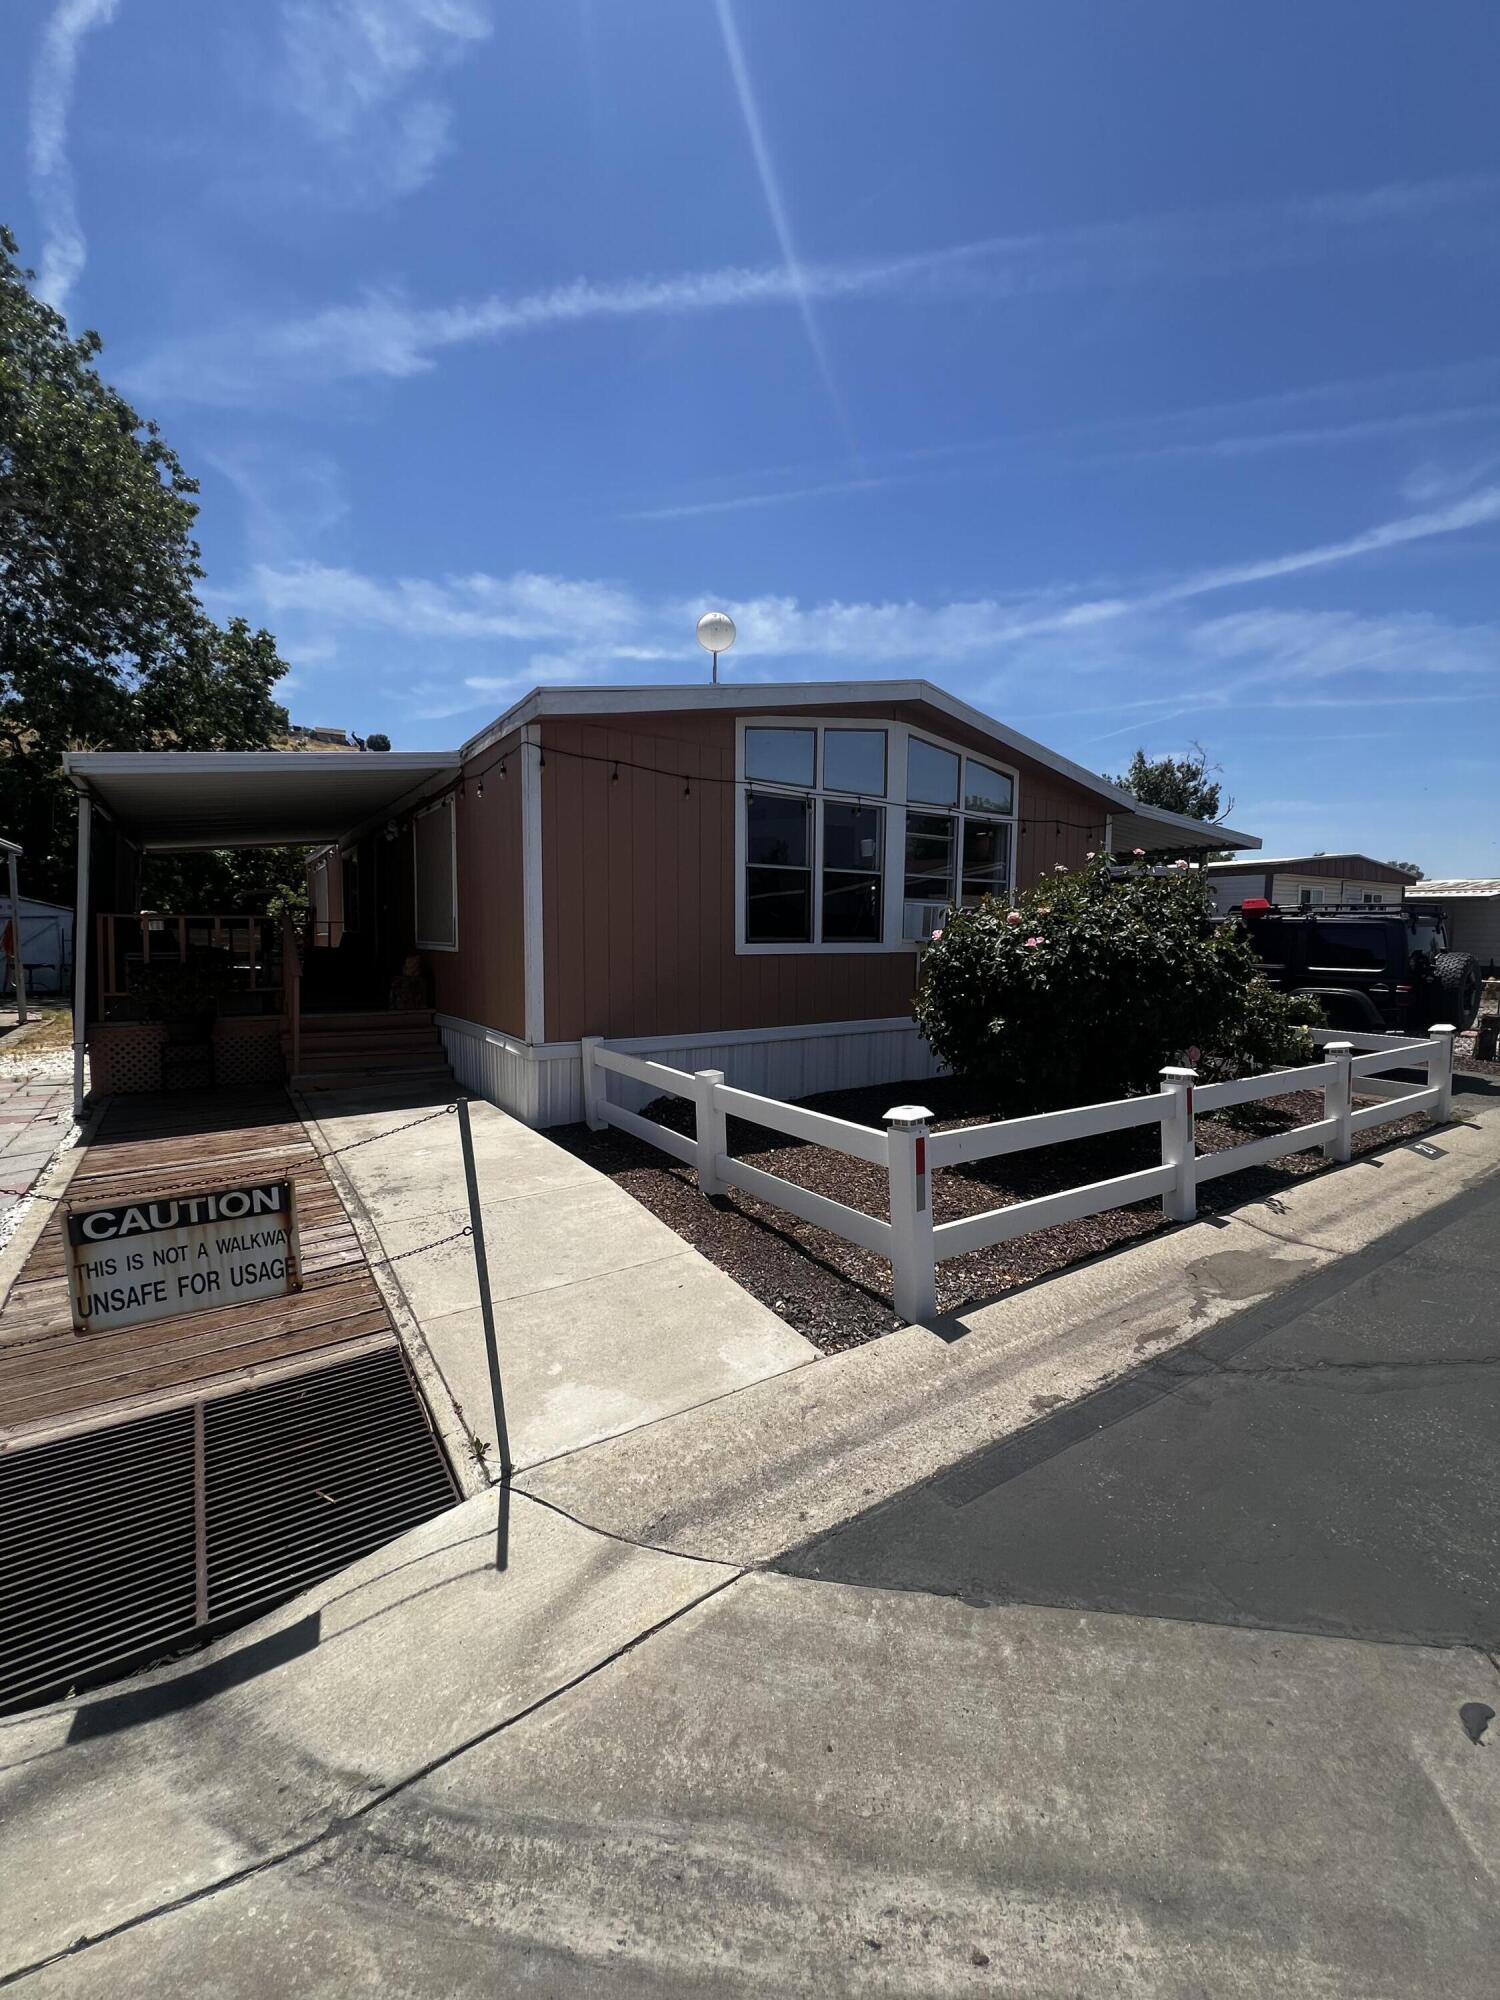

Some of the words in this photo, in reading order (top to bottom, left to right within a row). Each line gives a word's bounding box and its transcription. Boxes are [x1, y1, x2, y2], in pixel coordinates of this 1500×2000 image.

[82, 1187, 280, 1240] CAUTION
[74, 1258, 117, 1281] THIS
[127, 1254, 144, 1272] IS
[153, 1245, 188, 1266] NOT
[197, 1243, 208, 1259] A
[216, 1227, 293, 1254] WALKWAY
[77, 1280, 167, 1319] UNSAFE
[177, 1271, 220, 1298] FOR
[230, 1256, 297, 1287] USAGE
